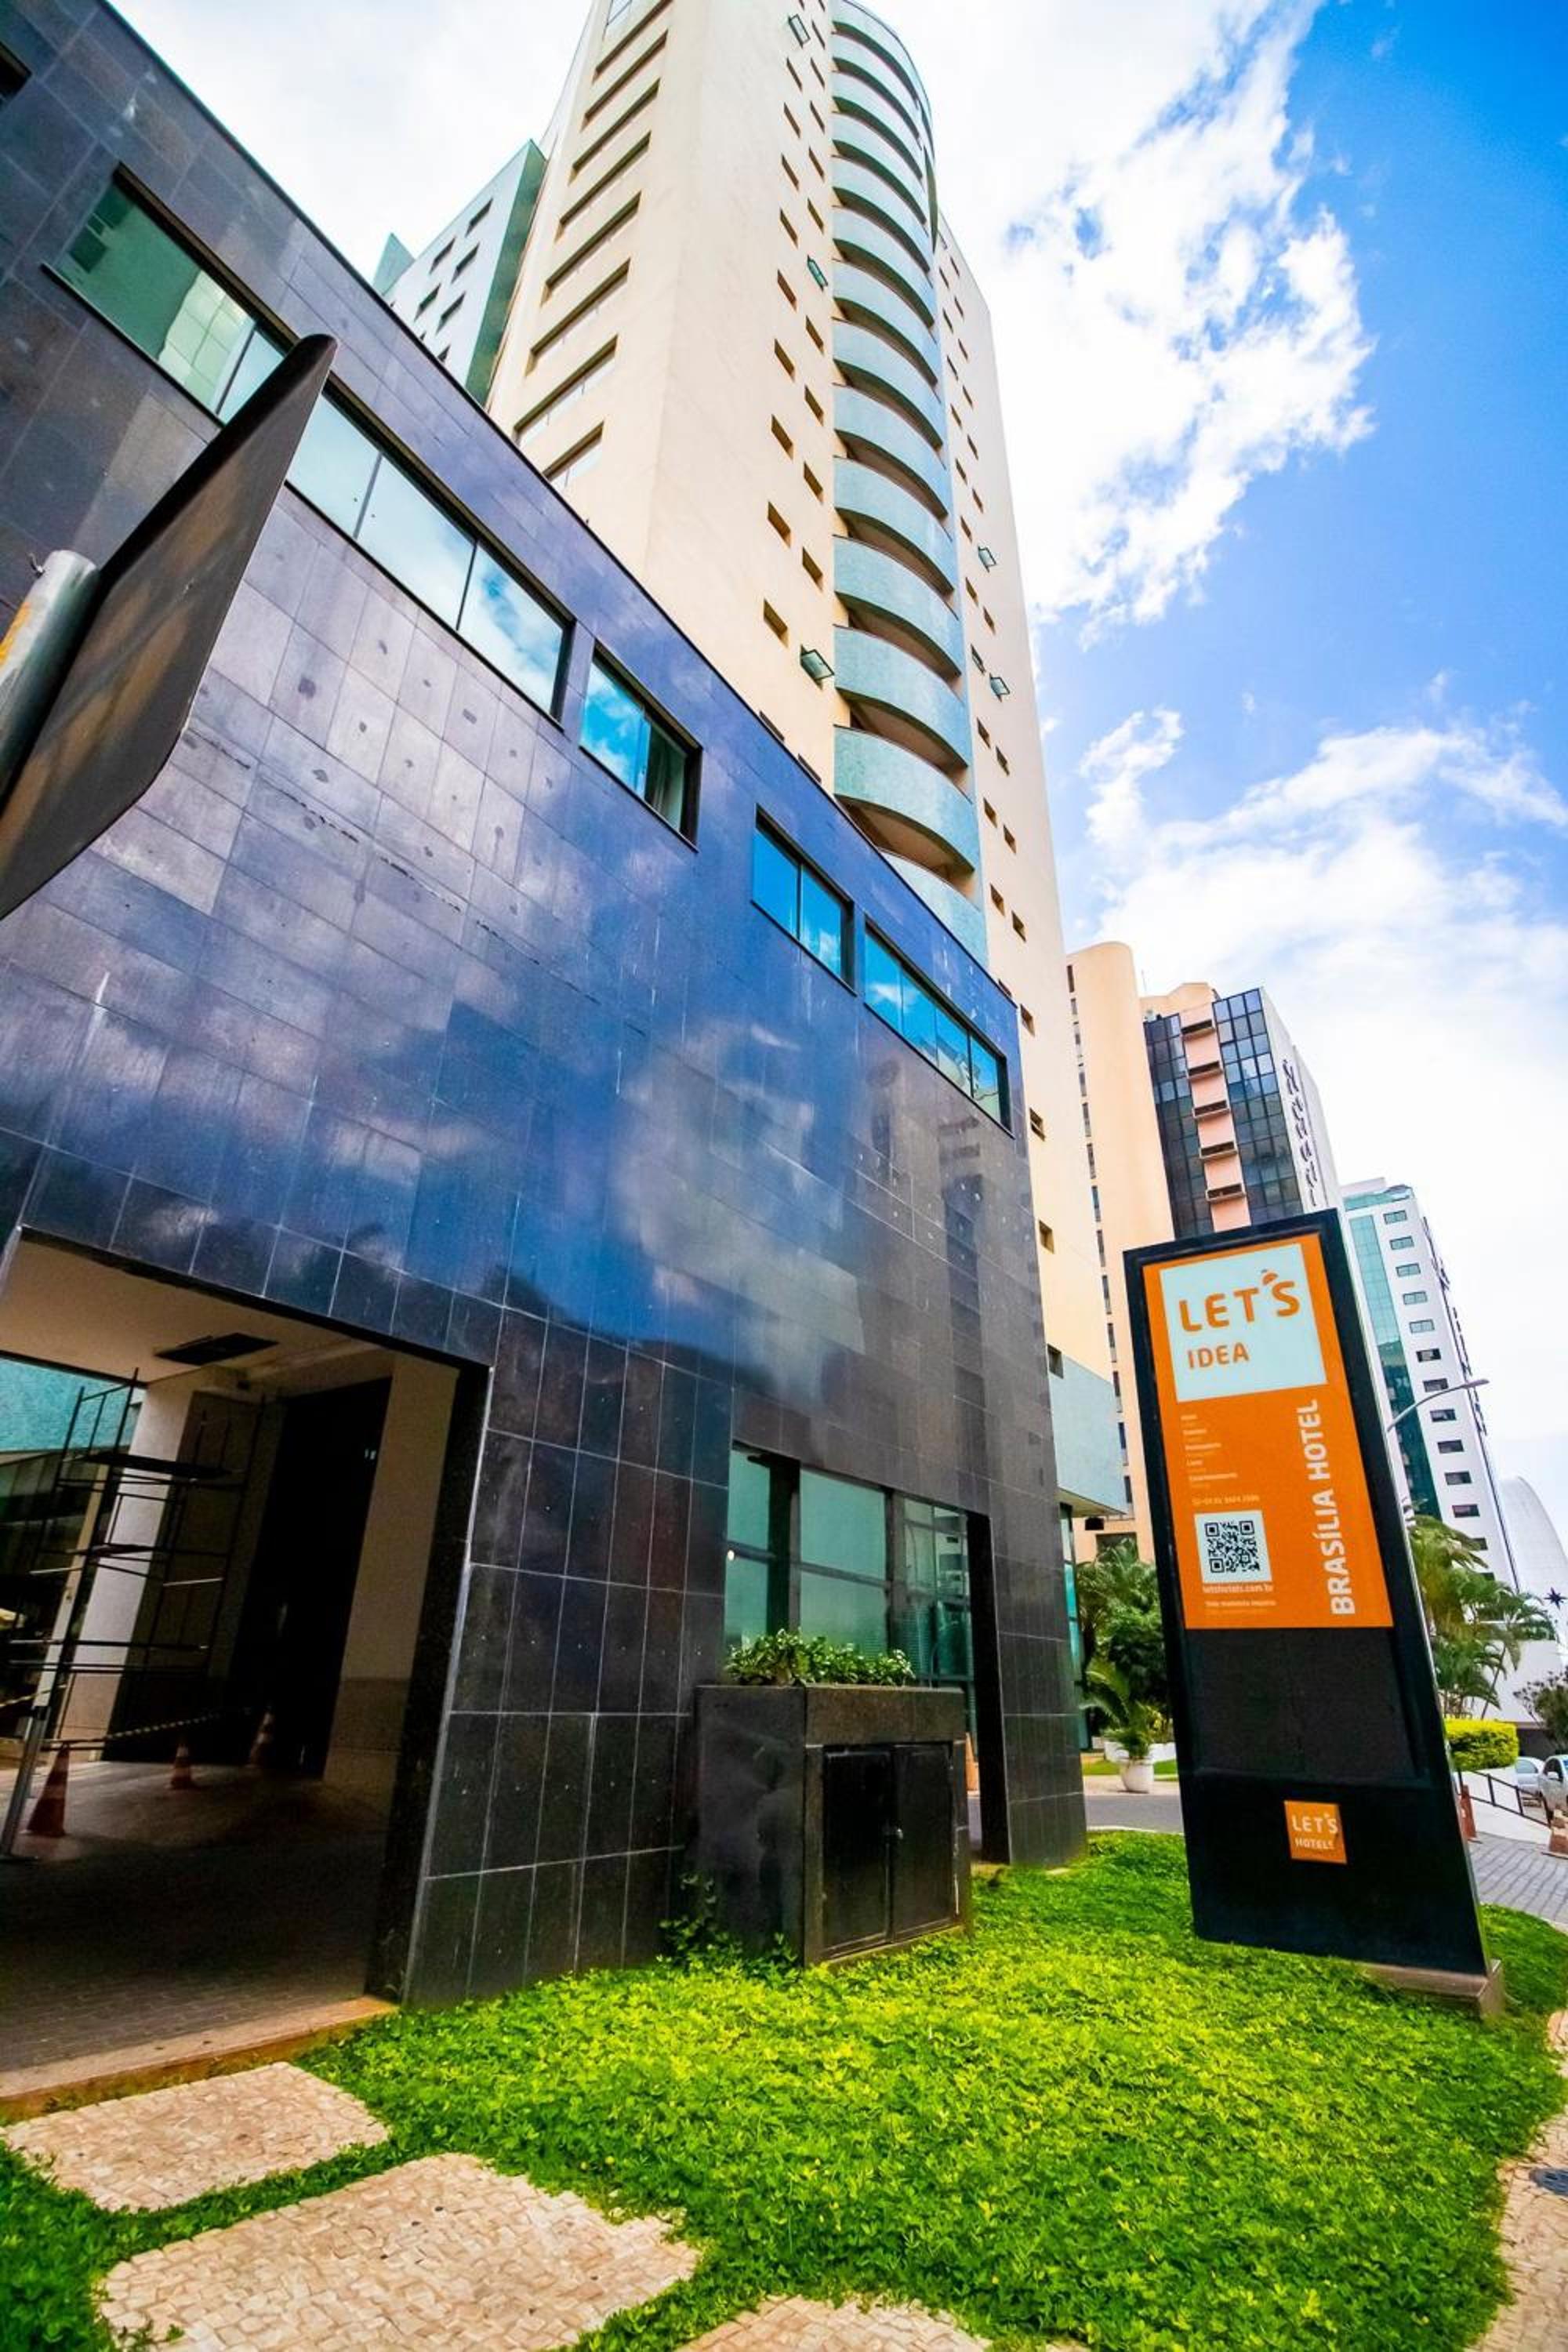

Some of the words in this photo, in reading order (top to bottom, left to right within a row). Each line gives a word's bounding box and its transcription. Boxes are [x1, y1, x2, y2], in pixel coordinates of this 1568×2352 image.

[1187, 1341, 1250, 1370] IDEA
[1296, 1399, 1330, 1481] HOTEL
[1312, 1488, 1356, 1615] BRASÍLIA
